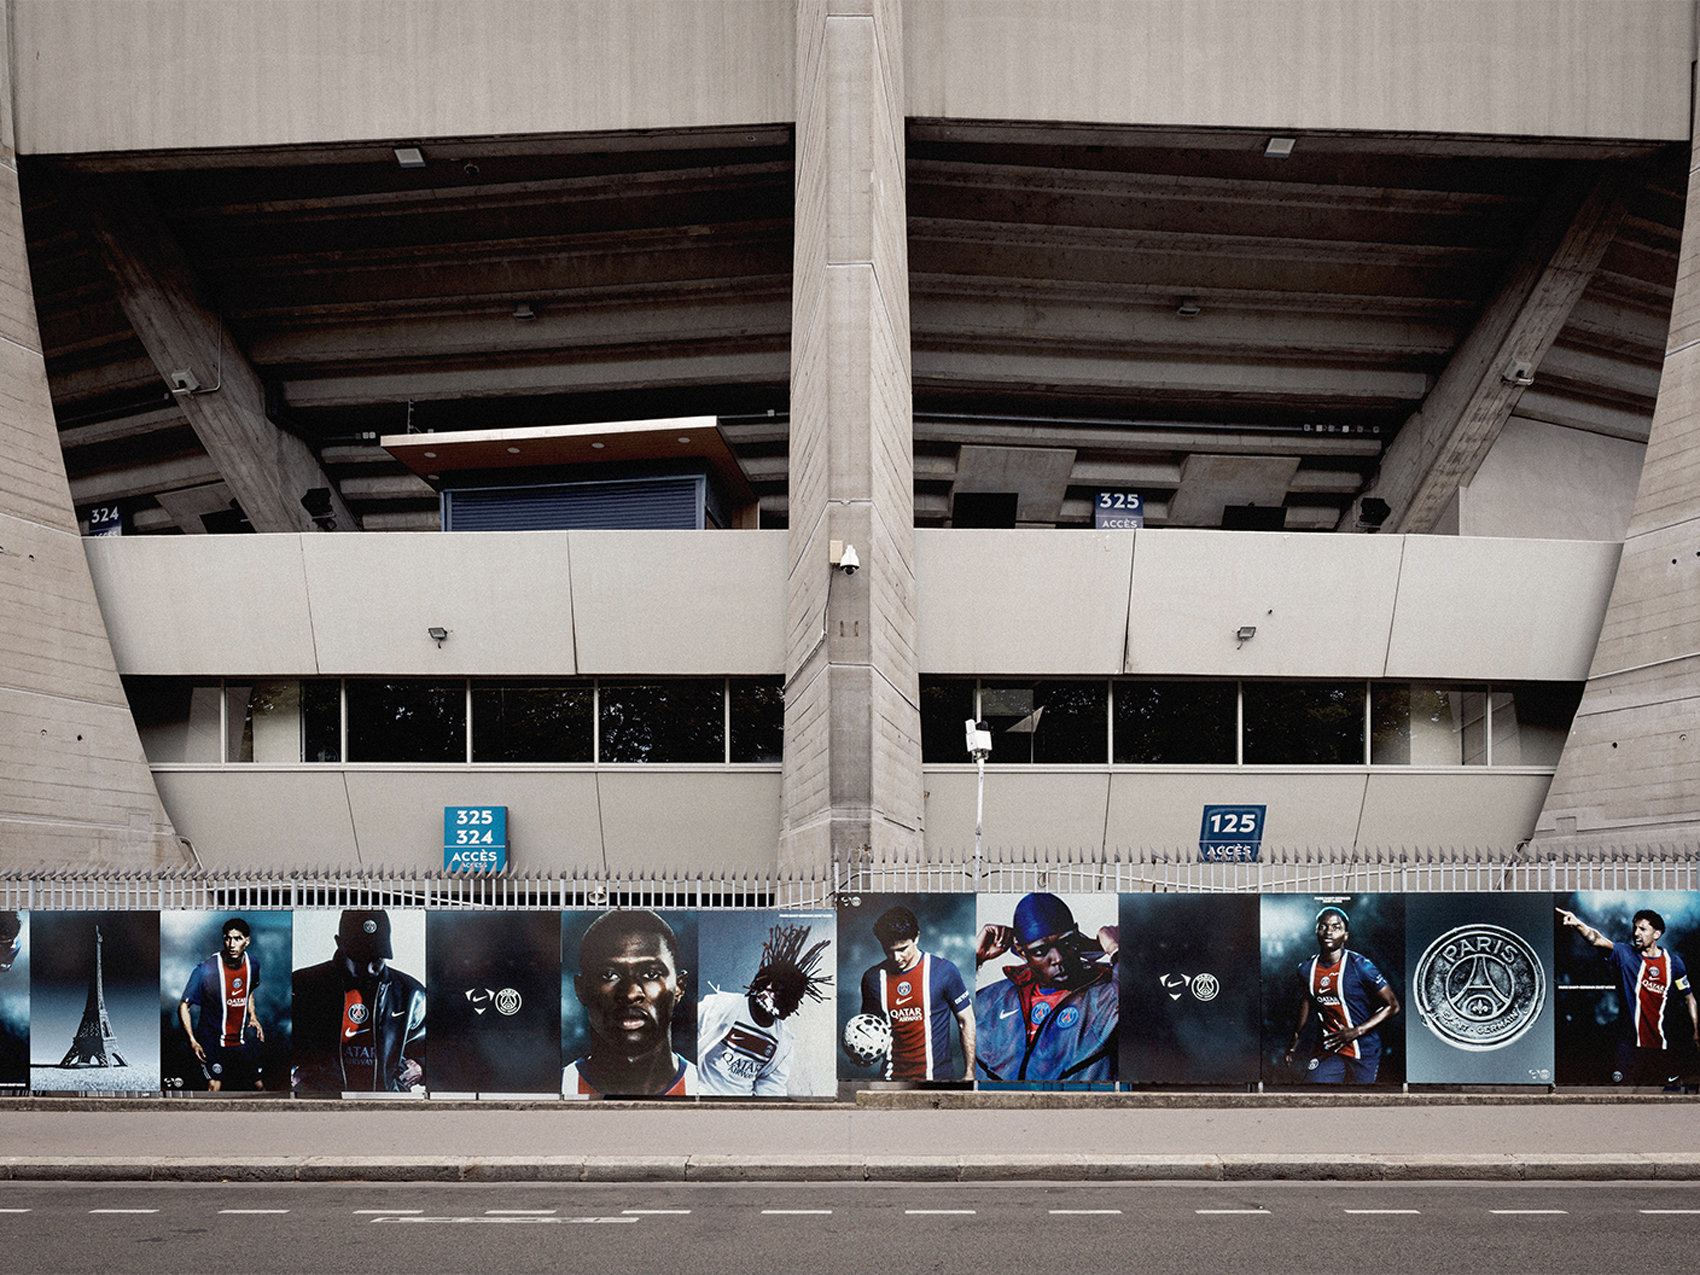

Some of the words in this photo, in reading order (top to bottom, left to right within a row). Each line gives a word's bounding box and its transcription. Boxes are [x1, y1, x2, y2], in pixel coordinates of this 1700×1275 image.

[1100, 492, 1139, 509] 325
[91, 506, 119, 523] 324
[1101, 518, 1138, 528] ACCÈS
[456, 810, 493, 824] 325
[1210, 814, 1256, 833] 125
[456, 829, 493, 844] 324
[451, 849, 498, 861] ACCÈS
[1442, 936, 1519, 963] PARIS
[890, 1007, 922, 1019] QATAR
[344, 1046, 376, 1058] ATAR
[344, 1058, 375, 1066] AIRWAY
